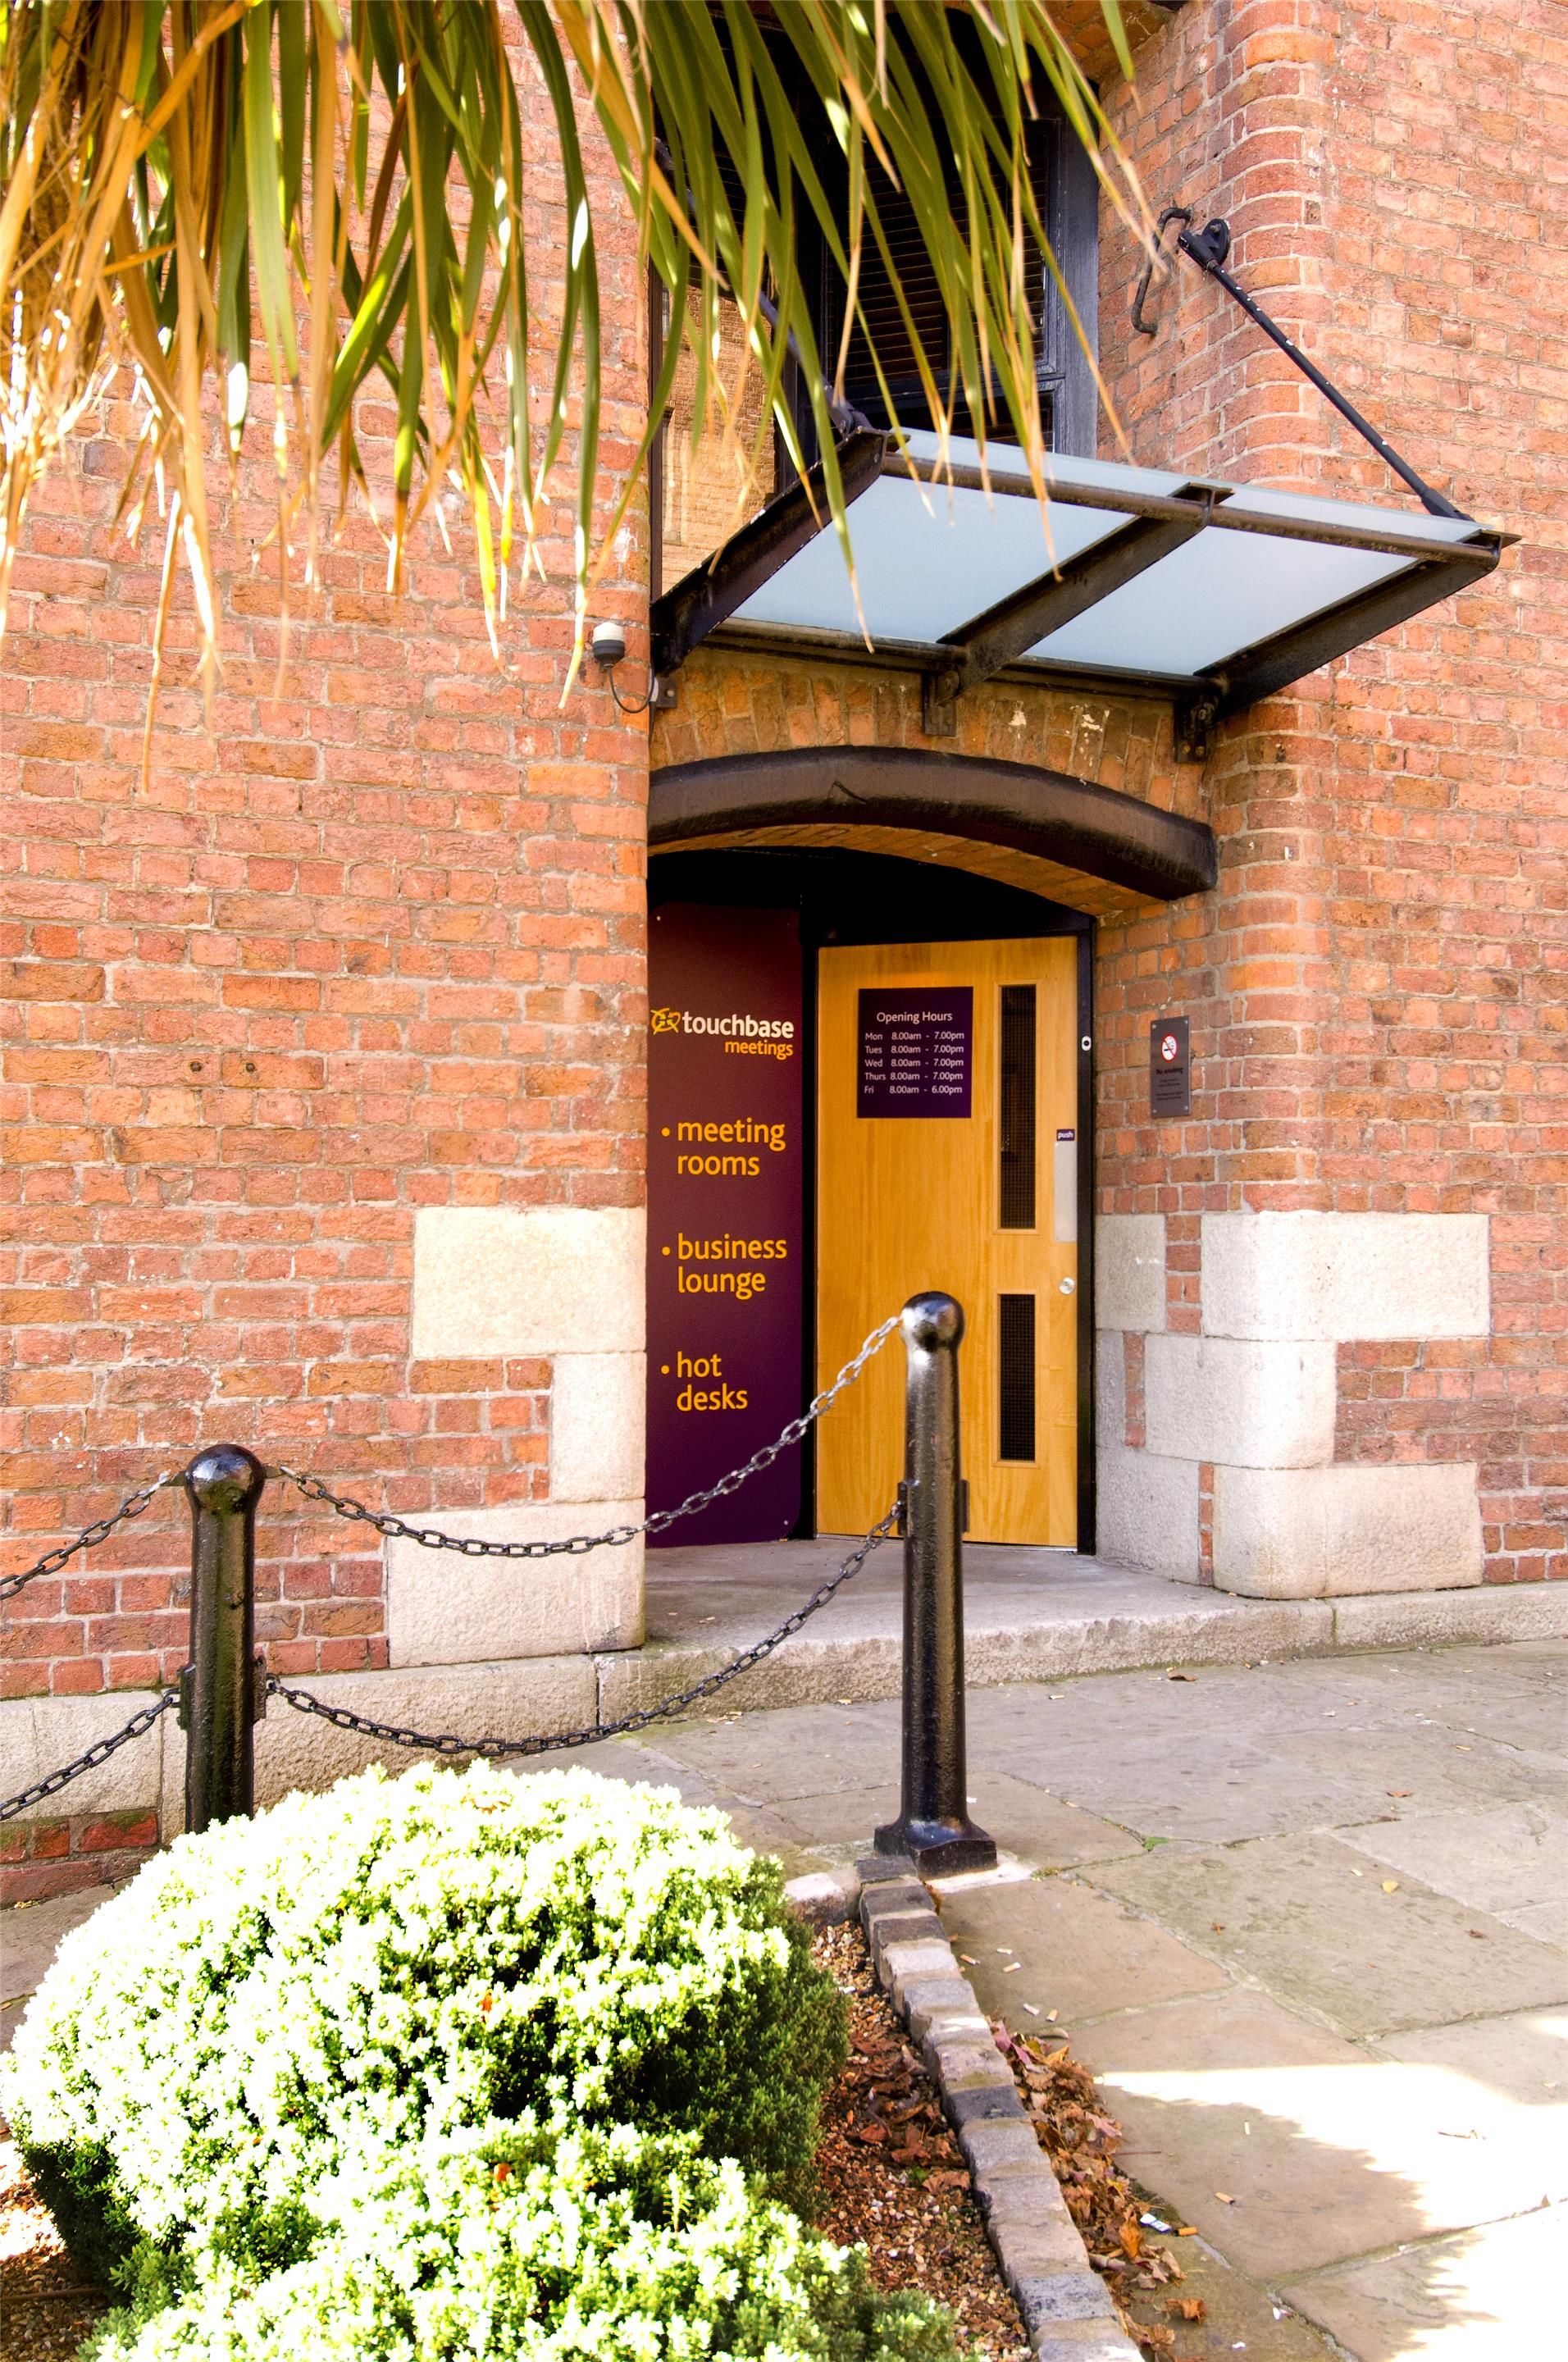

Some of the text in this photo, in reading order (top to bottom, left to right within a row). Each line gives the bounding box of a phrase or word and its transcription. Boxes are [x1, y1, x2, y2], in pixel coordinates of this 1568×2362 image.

[681, 1010, 795, 1038] touchbase
[877, 1011, 953, 1024] Opening Hours
[934, 1032, 964, 1042] 7.00pm
[724, 1040, 794, 1060] meetings
[864, 1046, 882, 1054] Tues
[891, 1046, 921, 1054] 8.00am
[934, 1045, 964, 1055] 7.00pm
[891, 1059, 920, 1067] 8.00am
[934, 1058, 964, 1068] 7.00pm
[890, 1072, 920, 1080] 8.00am
[933, 1072, 963, 1082] 7.00pm
[864, 1086, 874, 1094] Fri
[889, 1086, 919, 1094] 8.00am
[932, 1086, 962, 1095] 6.00pm
[677, 1117, 786, 1152] meeting
[1058, 1131, 1073, 1139] push
[677, 1156, 760, 1177] rooms
[677, 1233, 787, 1260] business
[678, 1266, 766, 1300] lounge
[677, 1351, 722, 1378] hot
[677, 1383, 749, 1411] desks
